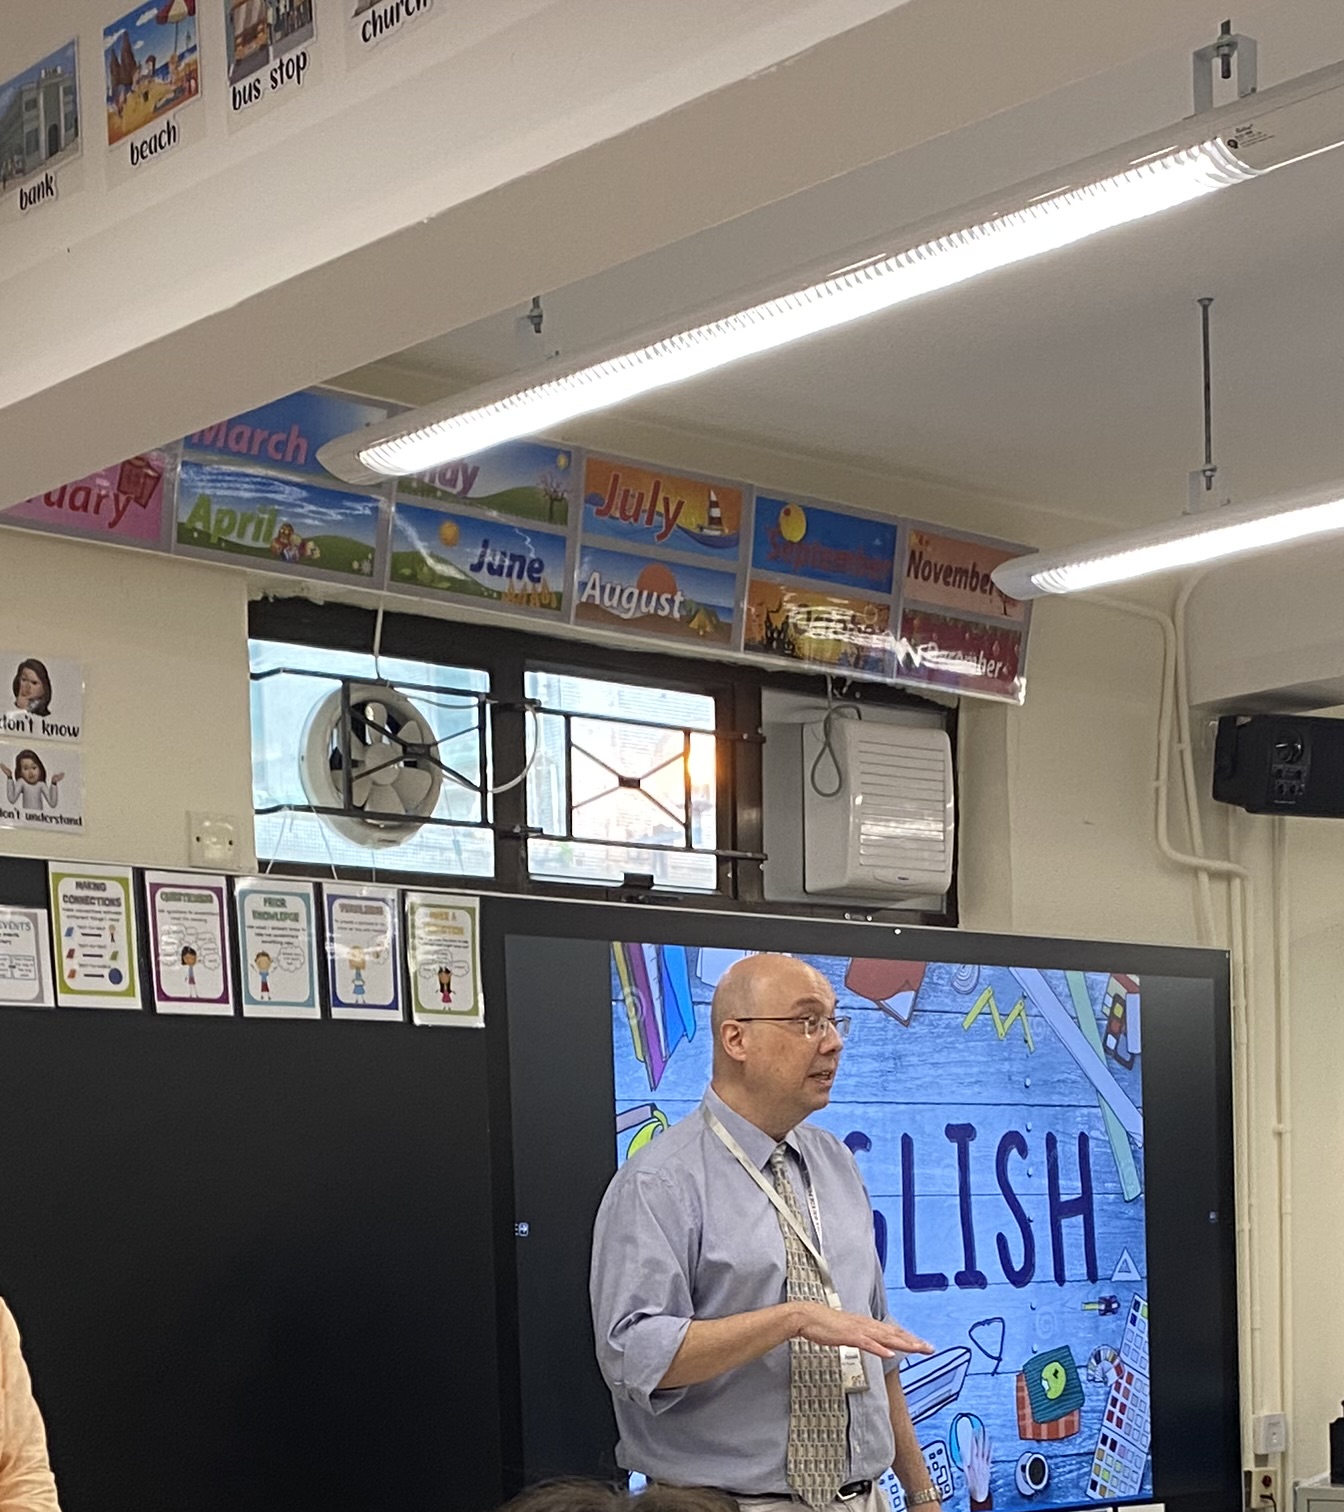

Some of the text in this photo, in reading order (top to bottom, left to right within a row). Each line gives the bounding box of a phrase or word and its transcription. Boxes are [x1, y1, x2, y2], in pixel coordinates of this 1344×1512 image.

[232, 51, 307, 111] bus stop
[130, 121, 178, 166] beach
[19, 174, 55, 211] bank
[191, 420, 309, 466] March
[186, 494, 277, 544] April
[595, 472, 686, 541] July
[470, 539, 544, 582] June
[766, 525, 895, 580] September
[907, 550, 998, 593] November
[581, 571, 684, 620] August
[42, 721, 79, 738] know
[844, 1122, 1098, 1291] LISH
